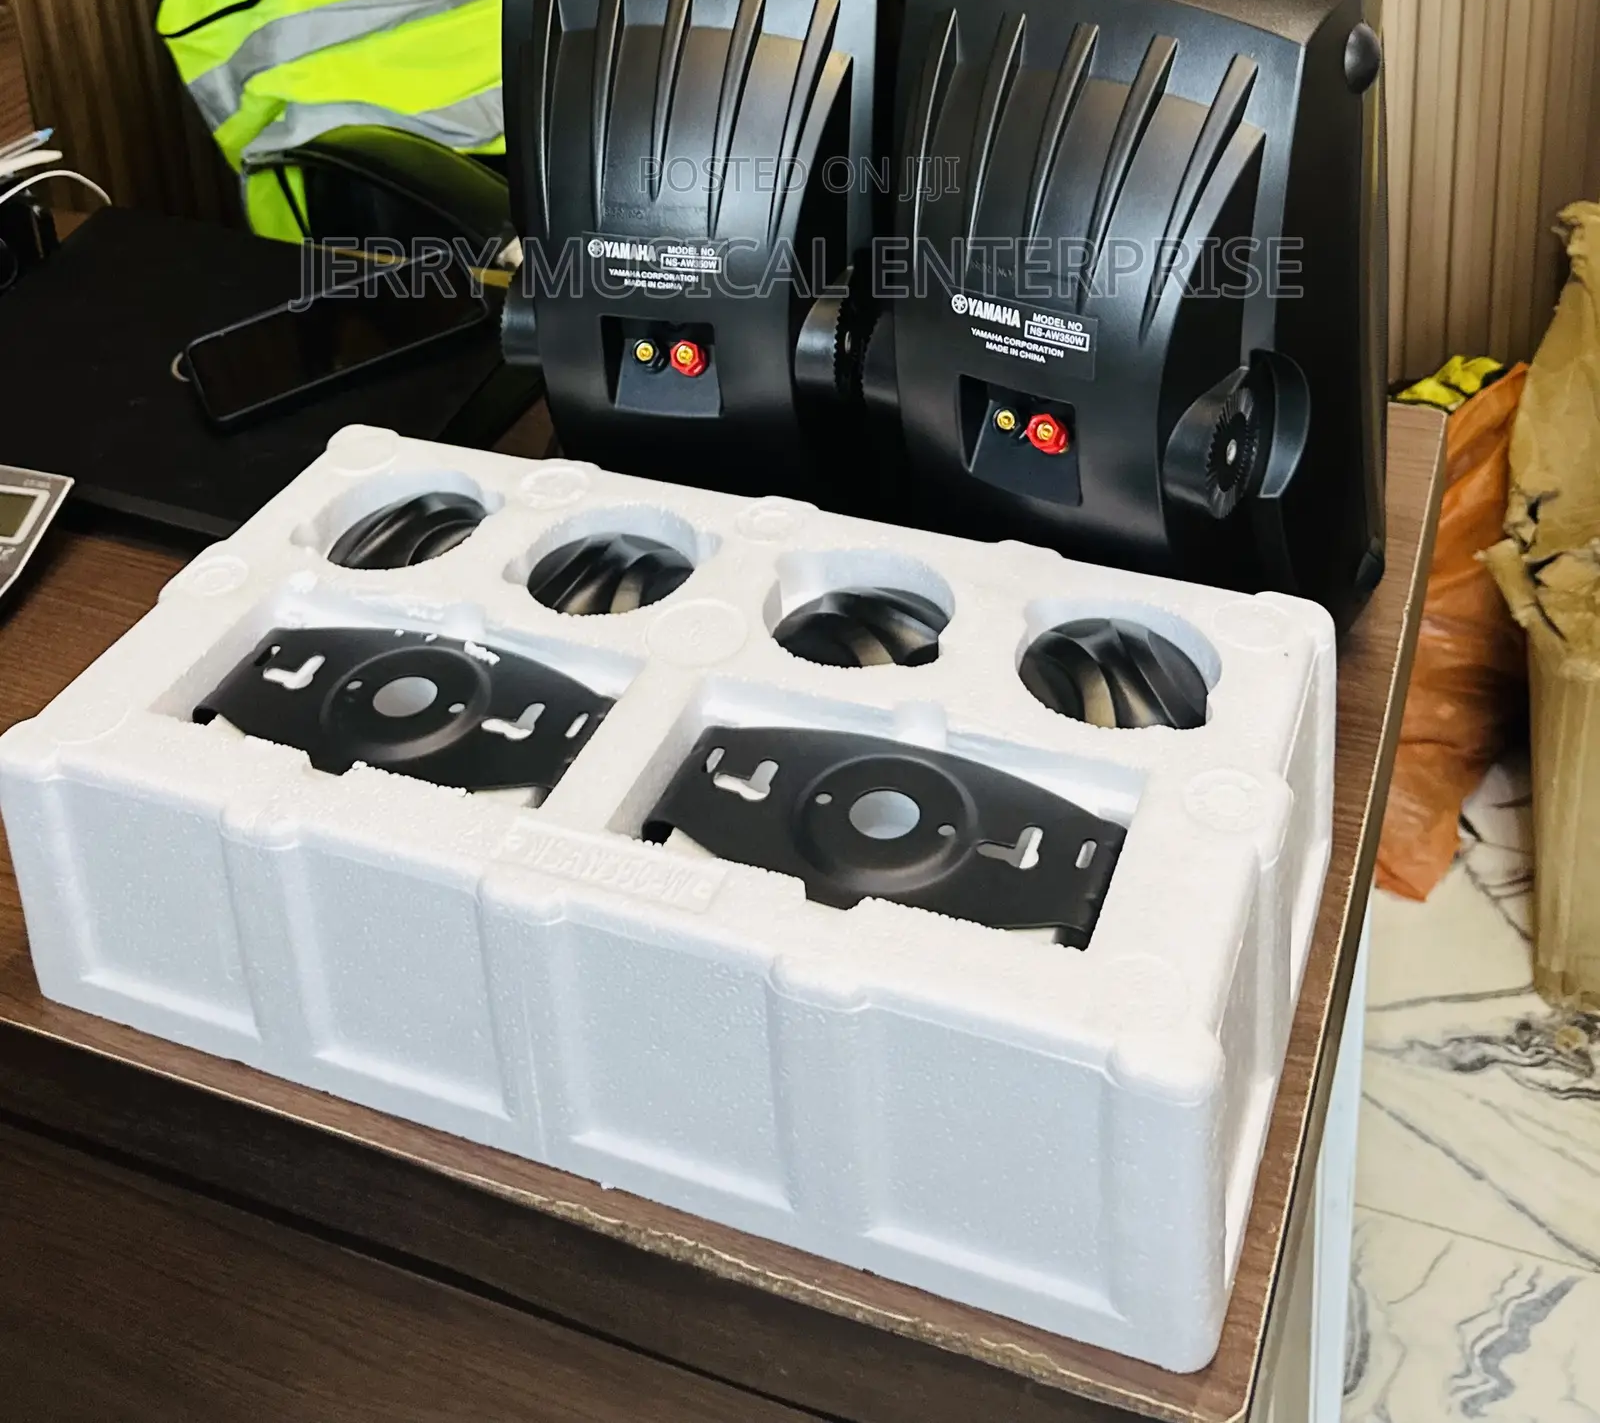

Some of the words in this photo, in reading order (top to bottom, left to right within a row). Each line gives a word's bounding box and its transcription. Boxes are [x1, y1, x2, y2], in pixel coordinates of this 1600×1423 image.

[604, 240, 656, 262] YAMAHA
[667, 245, 699, 256] MODEL
[608, 268, 641, 279] YAMAHA
[641, 270, 699, 283] CORPORATION
[624, 278, 647, 289] MADE
[647, 280, 656, 289] IN
[657, 281, 682, 291] CHINA
[968, 297, 1021, 328] YAMAHA
[1032, 312, 1066, 329] MODEL
[1067, 320, 1083, 332] NO
[970, 327, 1003, 343] YAMAHA
[1003, 336, 1064, 359] CORPORATION
[1029, 325, 1085, 347] NS-AW350W
[985, 341, 1009, 355] MADE
[1009, 347, 1018, 357] IN
[1019, 349, 1046, 364] CHINA
